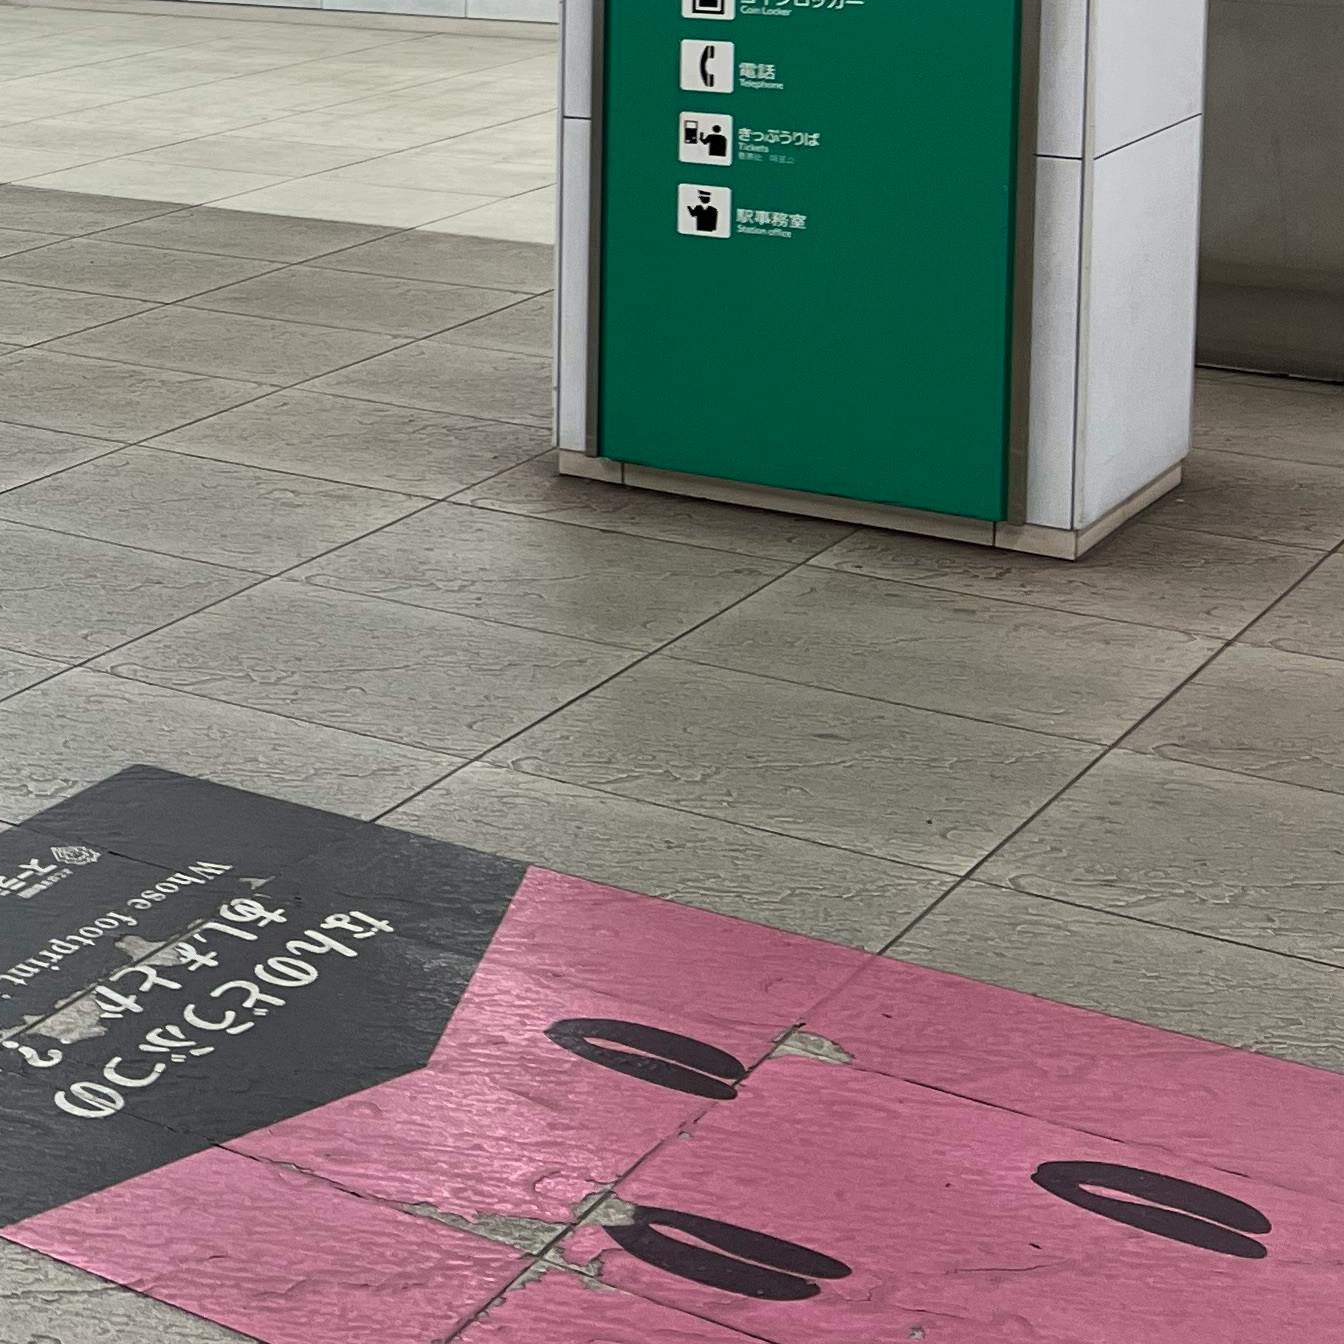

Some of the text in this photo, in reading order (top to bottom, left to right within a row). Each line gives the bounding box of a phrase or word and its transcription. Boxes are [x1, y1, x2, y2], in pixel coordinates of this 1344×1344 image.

[738, 62, 776, 80] 電話
[737, 128, 821, 147] きっぷうりば
[127, 860, 233, 911] Whose
[2, 896, 289, 1068] あしあとか?
[53, 909, 396, 1119] なんのどうぶつの
